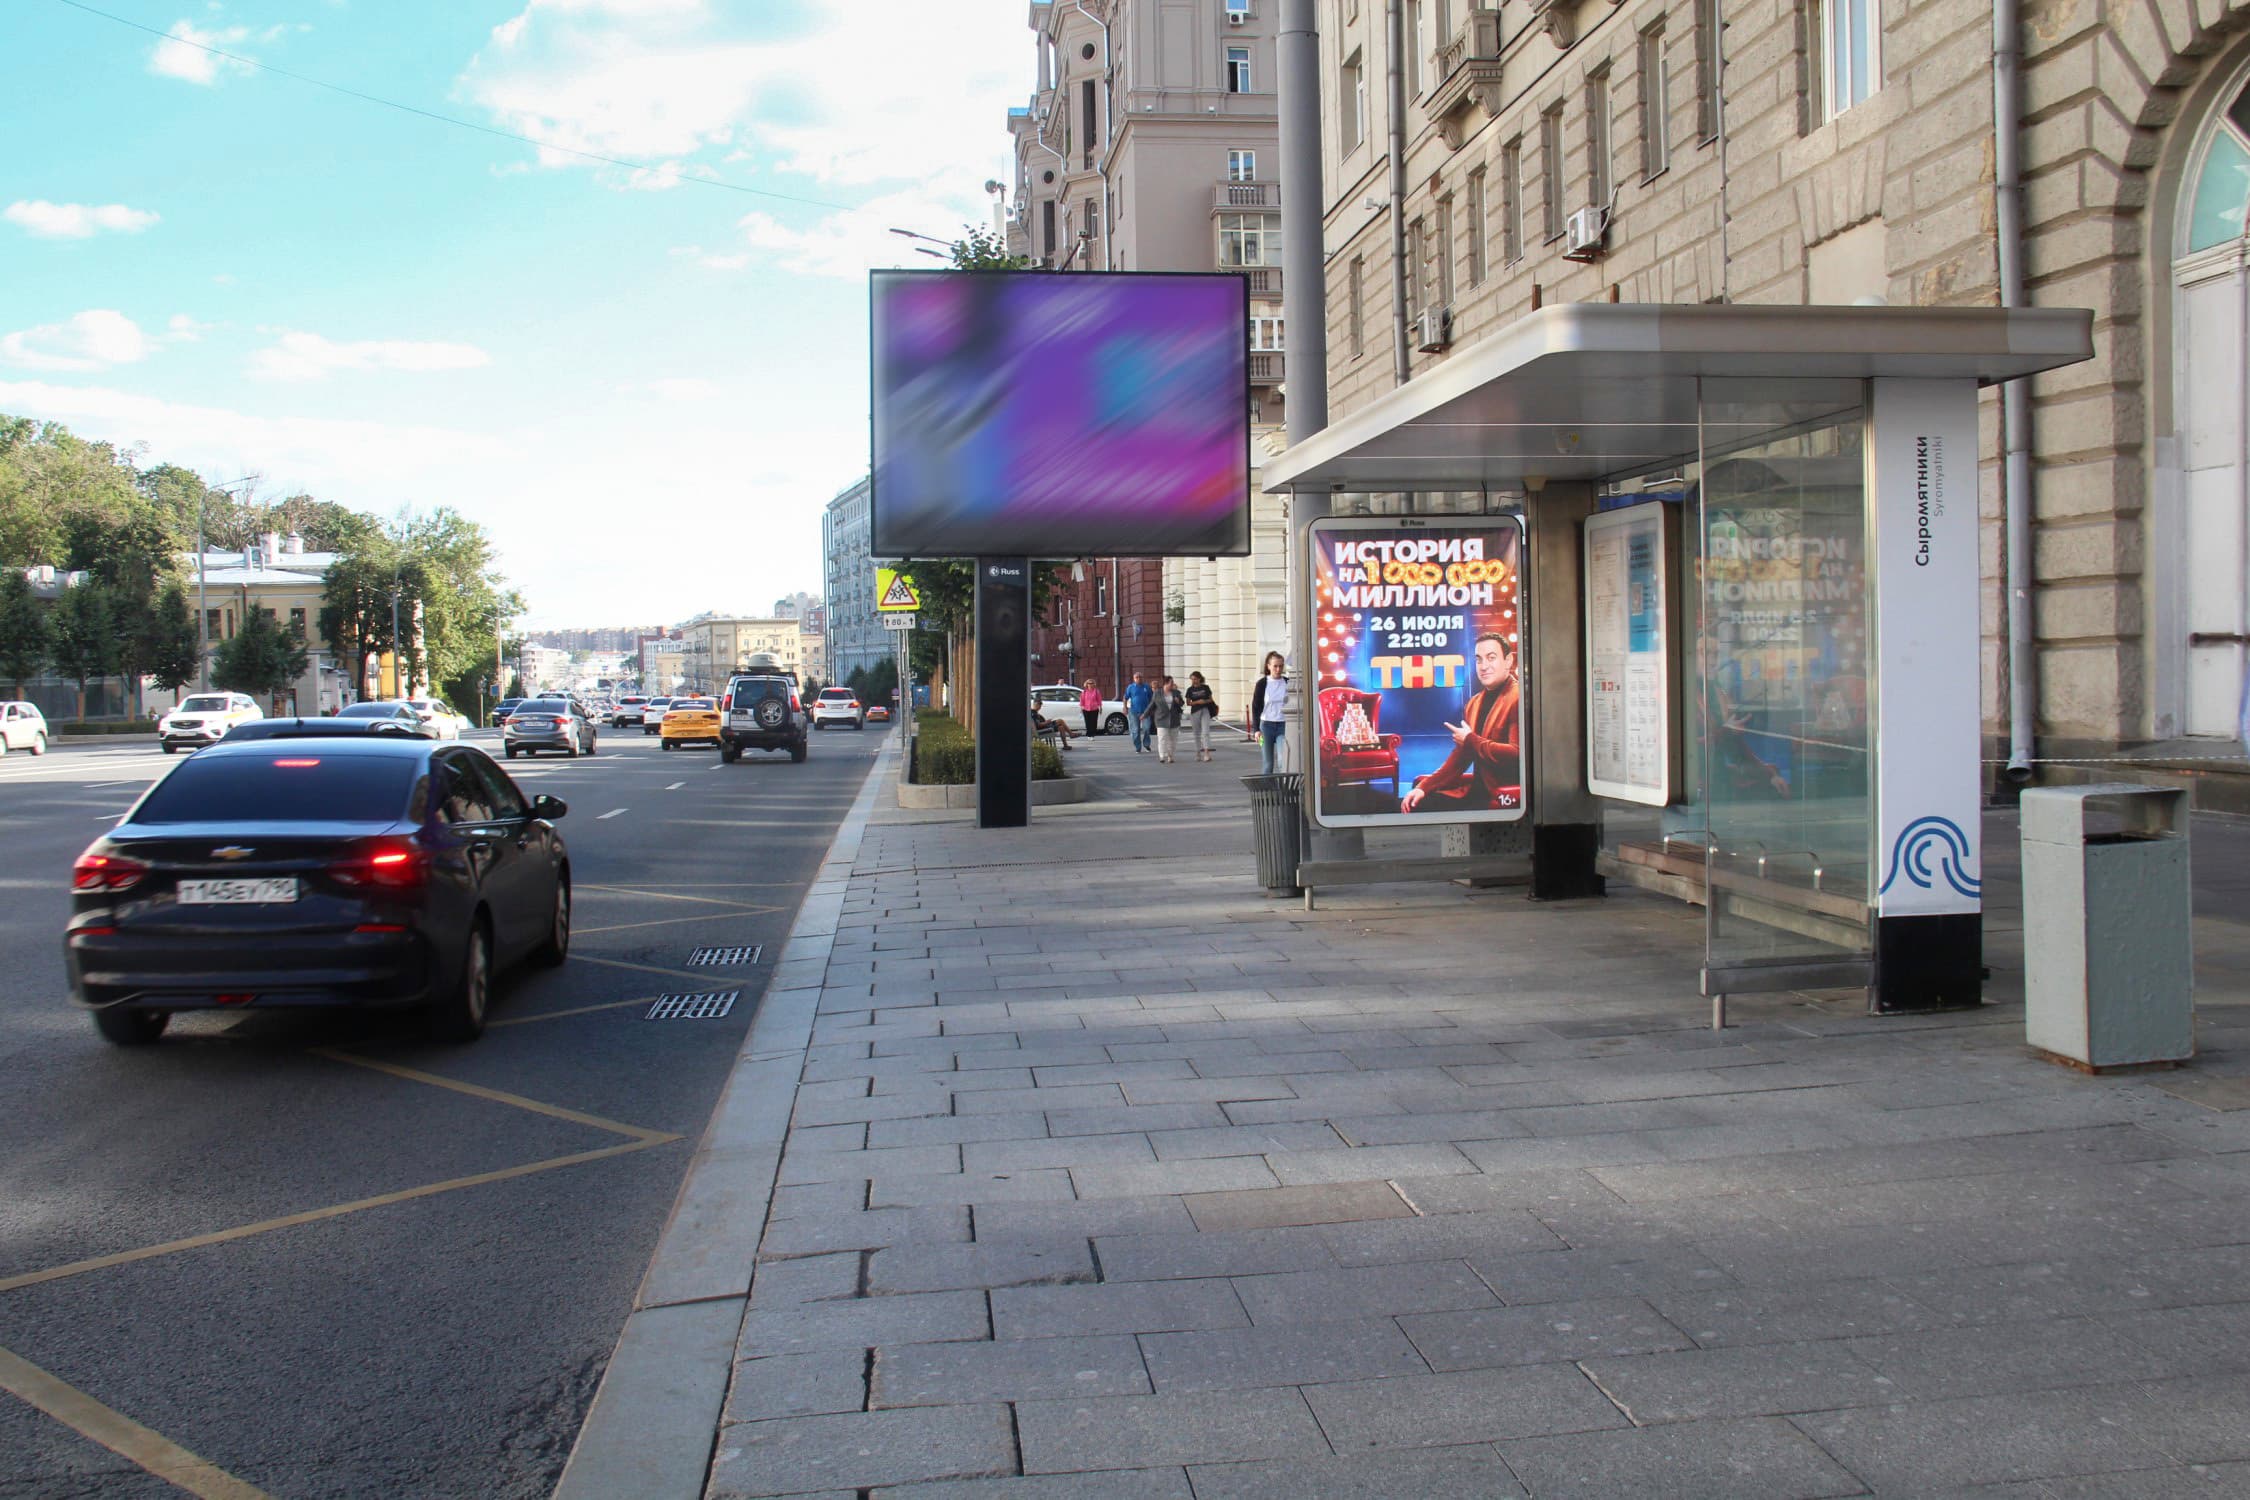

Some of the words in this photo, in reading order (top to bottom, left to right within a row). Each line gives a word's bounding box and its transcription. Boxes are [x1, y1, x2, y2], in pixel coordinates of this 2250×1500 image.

[1934, 436, 1944, 517] Syromyatniki
[1916, 436, 1932, 567] Сыромятники
[1335, 538, 1484, 565] ИСТОРИЯ
[1001, 567, 1020, 576] Russ
[1338, 567, 1367, 583] НА
[1332, 584, 1494, 609] МИЛЛИОН
[1370, 616, 1397, 632] 26
[1402, 615, 1464, 631] ИЮЛЯ
[1387, 632, 1448, 648] 22:00
[1370, 654, 1465, 689] ТНТ
[1498, 794, 1516, 806] 16+
